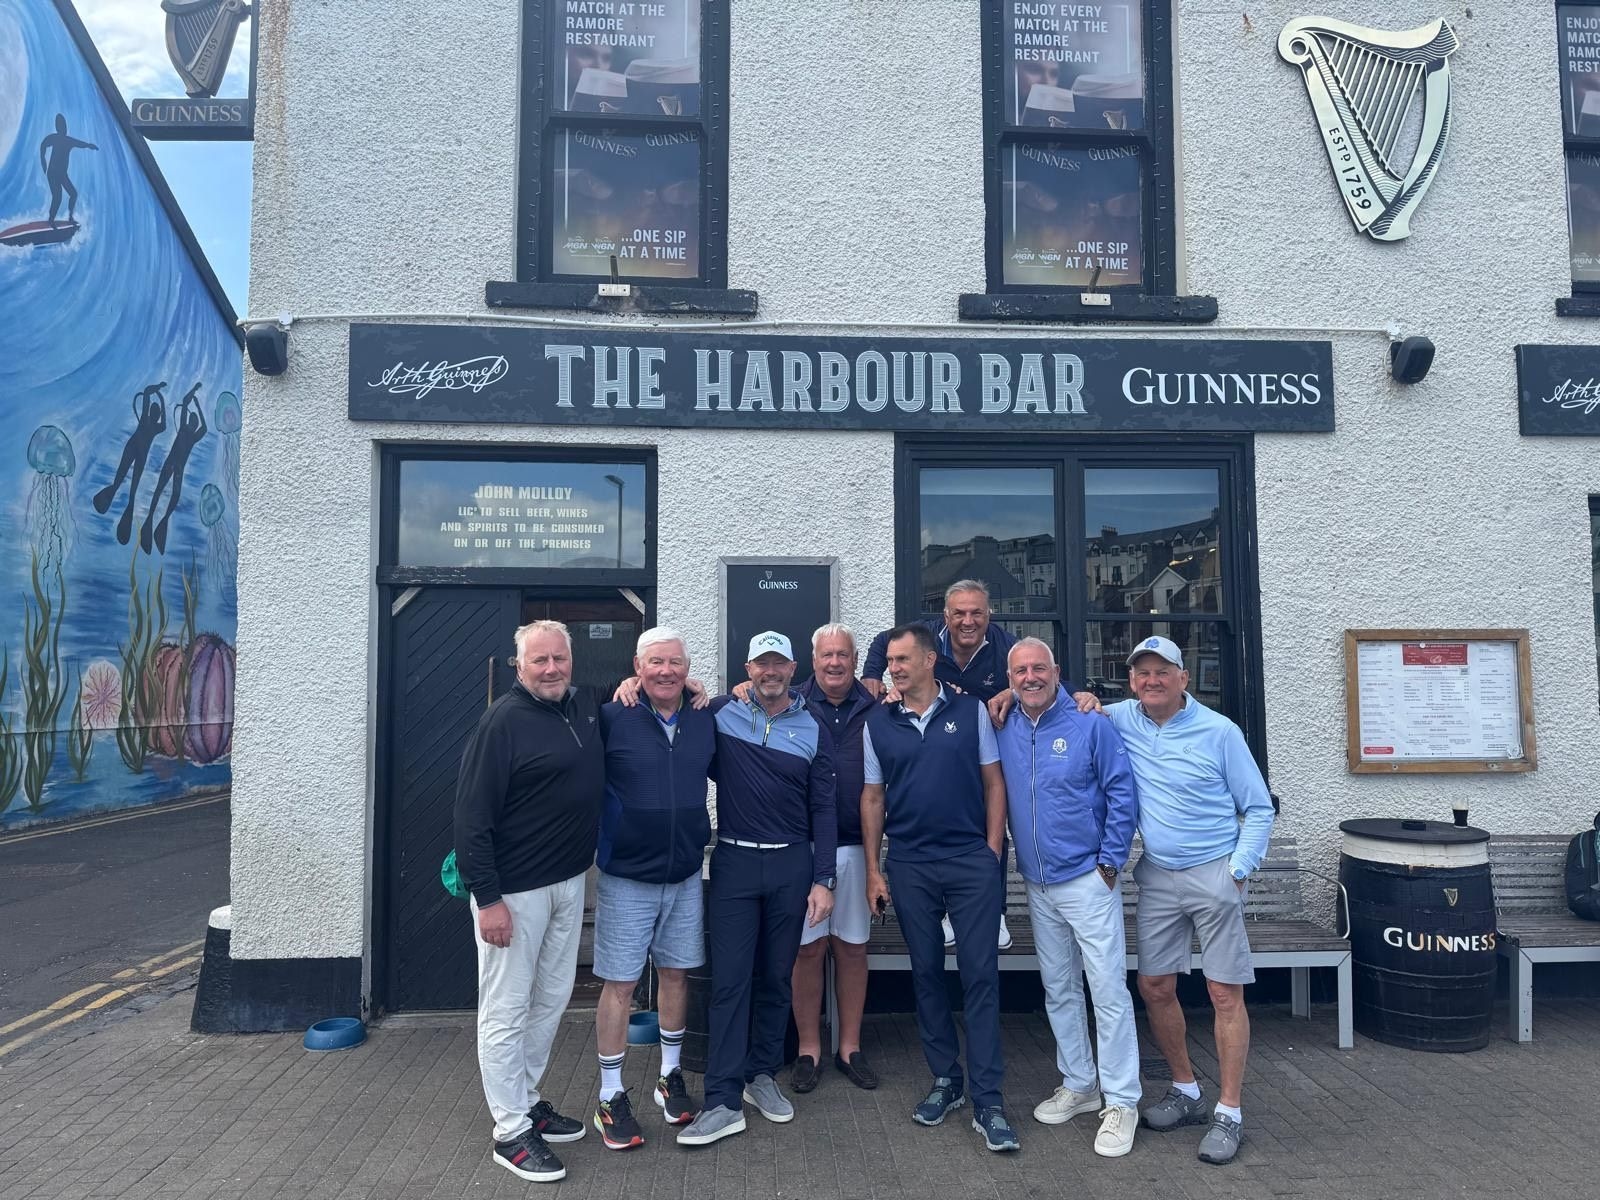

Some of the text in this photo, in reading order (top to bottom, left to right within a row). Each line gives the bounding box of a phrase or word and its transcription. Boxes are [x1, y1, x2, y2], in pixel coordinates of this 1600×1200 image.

[566, 1, 665, 17] MATCH AT THE
[1014, 3, 1102, 18] ENJOY EVERY
[566, 17, 624, 31] RAMORE
[1014, 18, 1109, 33] MATCH AT THE
[1566, 17, 1600, 30] ENJO
[565, 32, 656, 47] RESTAURANT
[1014, 33, 1069, 47] RAMORE
[1015, 48, 1100, 63] RESTAURANT
[1569, 60, 1600, 73] REST
[136, 102, 242, 122] GUINNESS
[575, 129, 638, 157] GUINNESS
[1021, 143, 1081, 171] GUINNESS
[1342, 166, 1372, 210] 1759
[664, 230, 686, 244] SIP
[619, 245, 687, 260] AT A TIME
[1107, 242, 1129, 255] SIP
[1065, 256, 1129, 270] AT A TIME
[544, 344, 1088, 414] THE HARBOUR BAR
[1122, 367, 1321, 405] GUINNESS
[475, 485, 573, 500] JOHN MOLLOY
[480, 506, 493, 517] TO
[499, 507, 520, 517] SELL
[527, 507, 554, 519] BEER,
[556, 508, 588, 518] WINES
[440, 521, 605, 534] AND SPIRITS TO BE CONSUMED
[453, 538, 591, 549] ON OR OFF THE PREMISES
[758, 579, 798, 590] GUINNESS
[1383, 926, 1496, 953] GUINNESS
